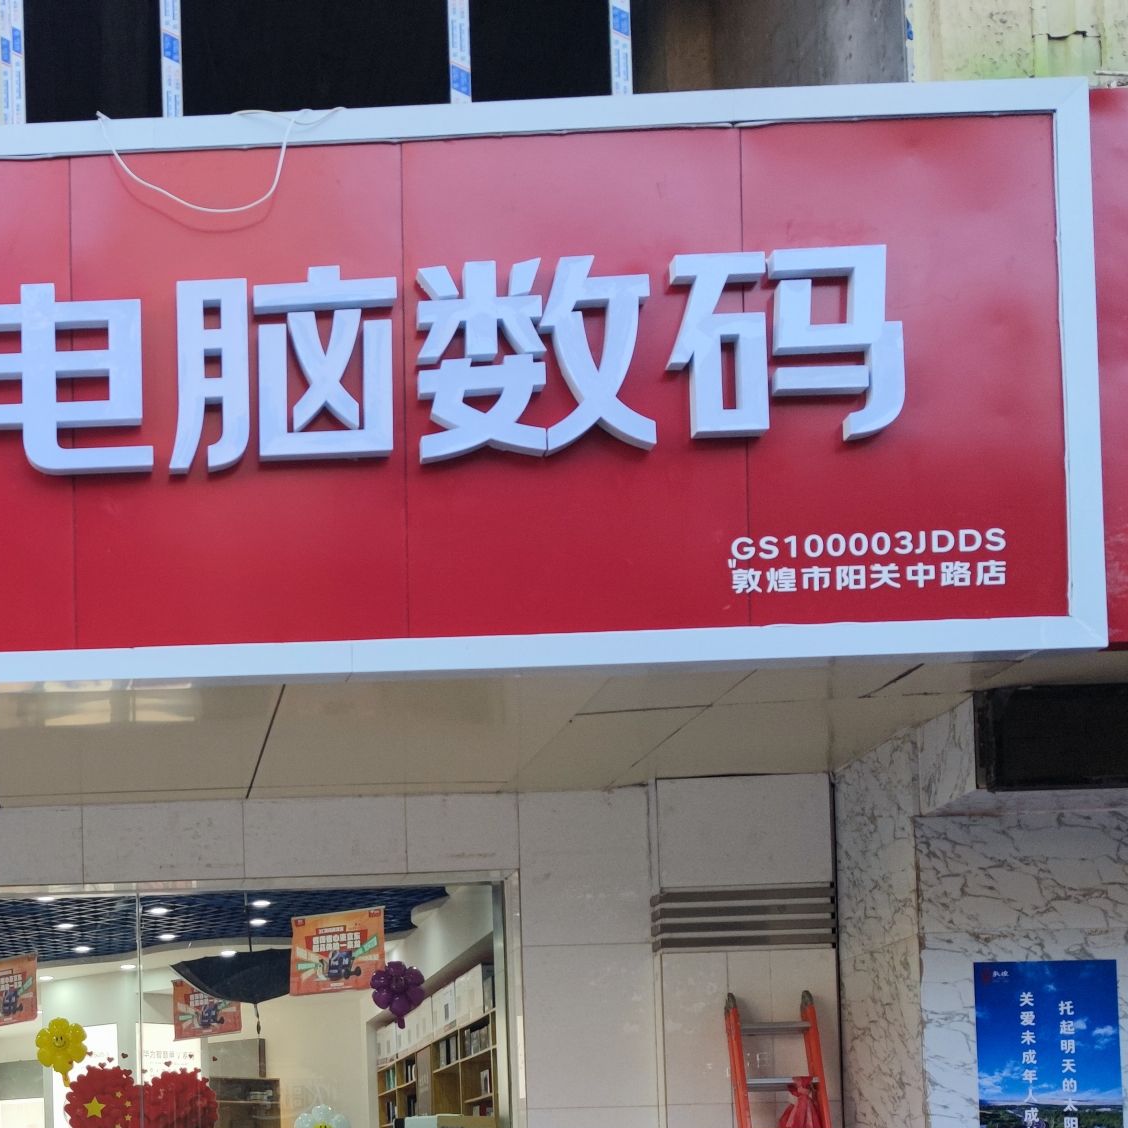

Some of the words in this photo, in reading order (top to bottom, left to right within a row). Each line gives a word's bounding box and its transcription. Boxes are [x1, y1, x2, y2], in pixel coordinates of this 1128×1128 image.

[731, 527, 1008, 562] GS100003JDDS
[731, 560, 1008, 595] 敦煌市阳关中路店
